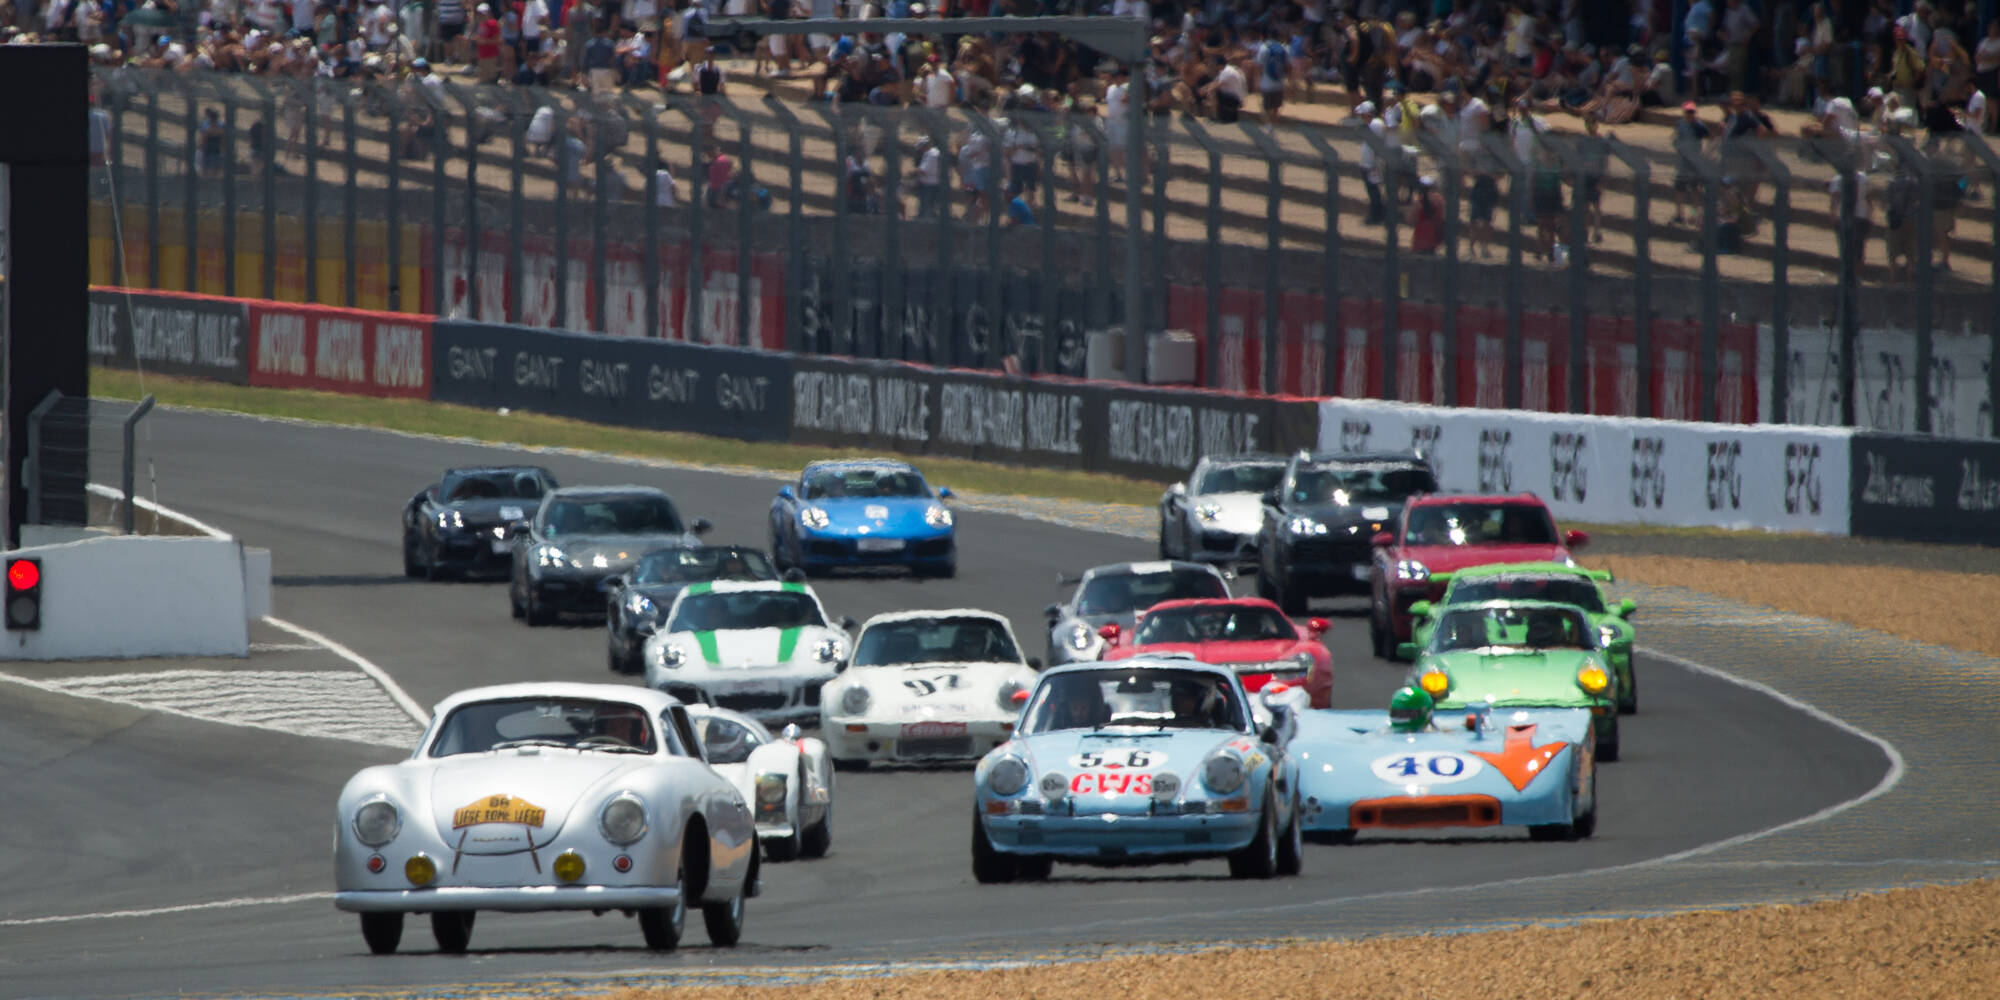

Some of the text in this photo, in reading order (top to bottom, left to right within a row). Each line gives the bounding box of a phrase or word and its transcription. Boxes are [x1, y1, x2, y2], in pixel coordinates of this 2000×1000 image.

[258, 314, 306, 377] MOTUL
[315, 318, 364, 383] MOTUL
[373, 324, 424, 388] MOTUL
[449, 345, 498, 380] GANT
[514, 351, 563, 388] GANT
[579, 357, 630, 397] GANT
[648, 363, 700, 403] GANT
[716, 372, 769, 412] GANT
[793, 371, 929, 440] RICHARD MILLE
[939, 382, 1082, 454] RICHARD MILLE
[1109, 400, 1194, 470] RICHARD
[1551, 431, 1586, 504] EFG
[1630, 437, 1665, 509] EFG
[1707, 440, 1741, 511] EFG
[1785, 441, 1821, 516] EFG
[1069, 771, 1153, 796] CWS
[1386, 755, 1465, 777] 40
